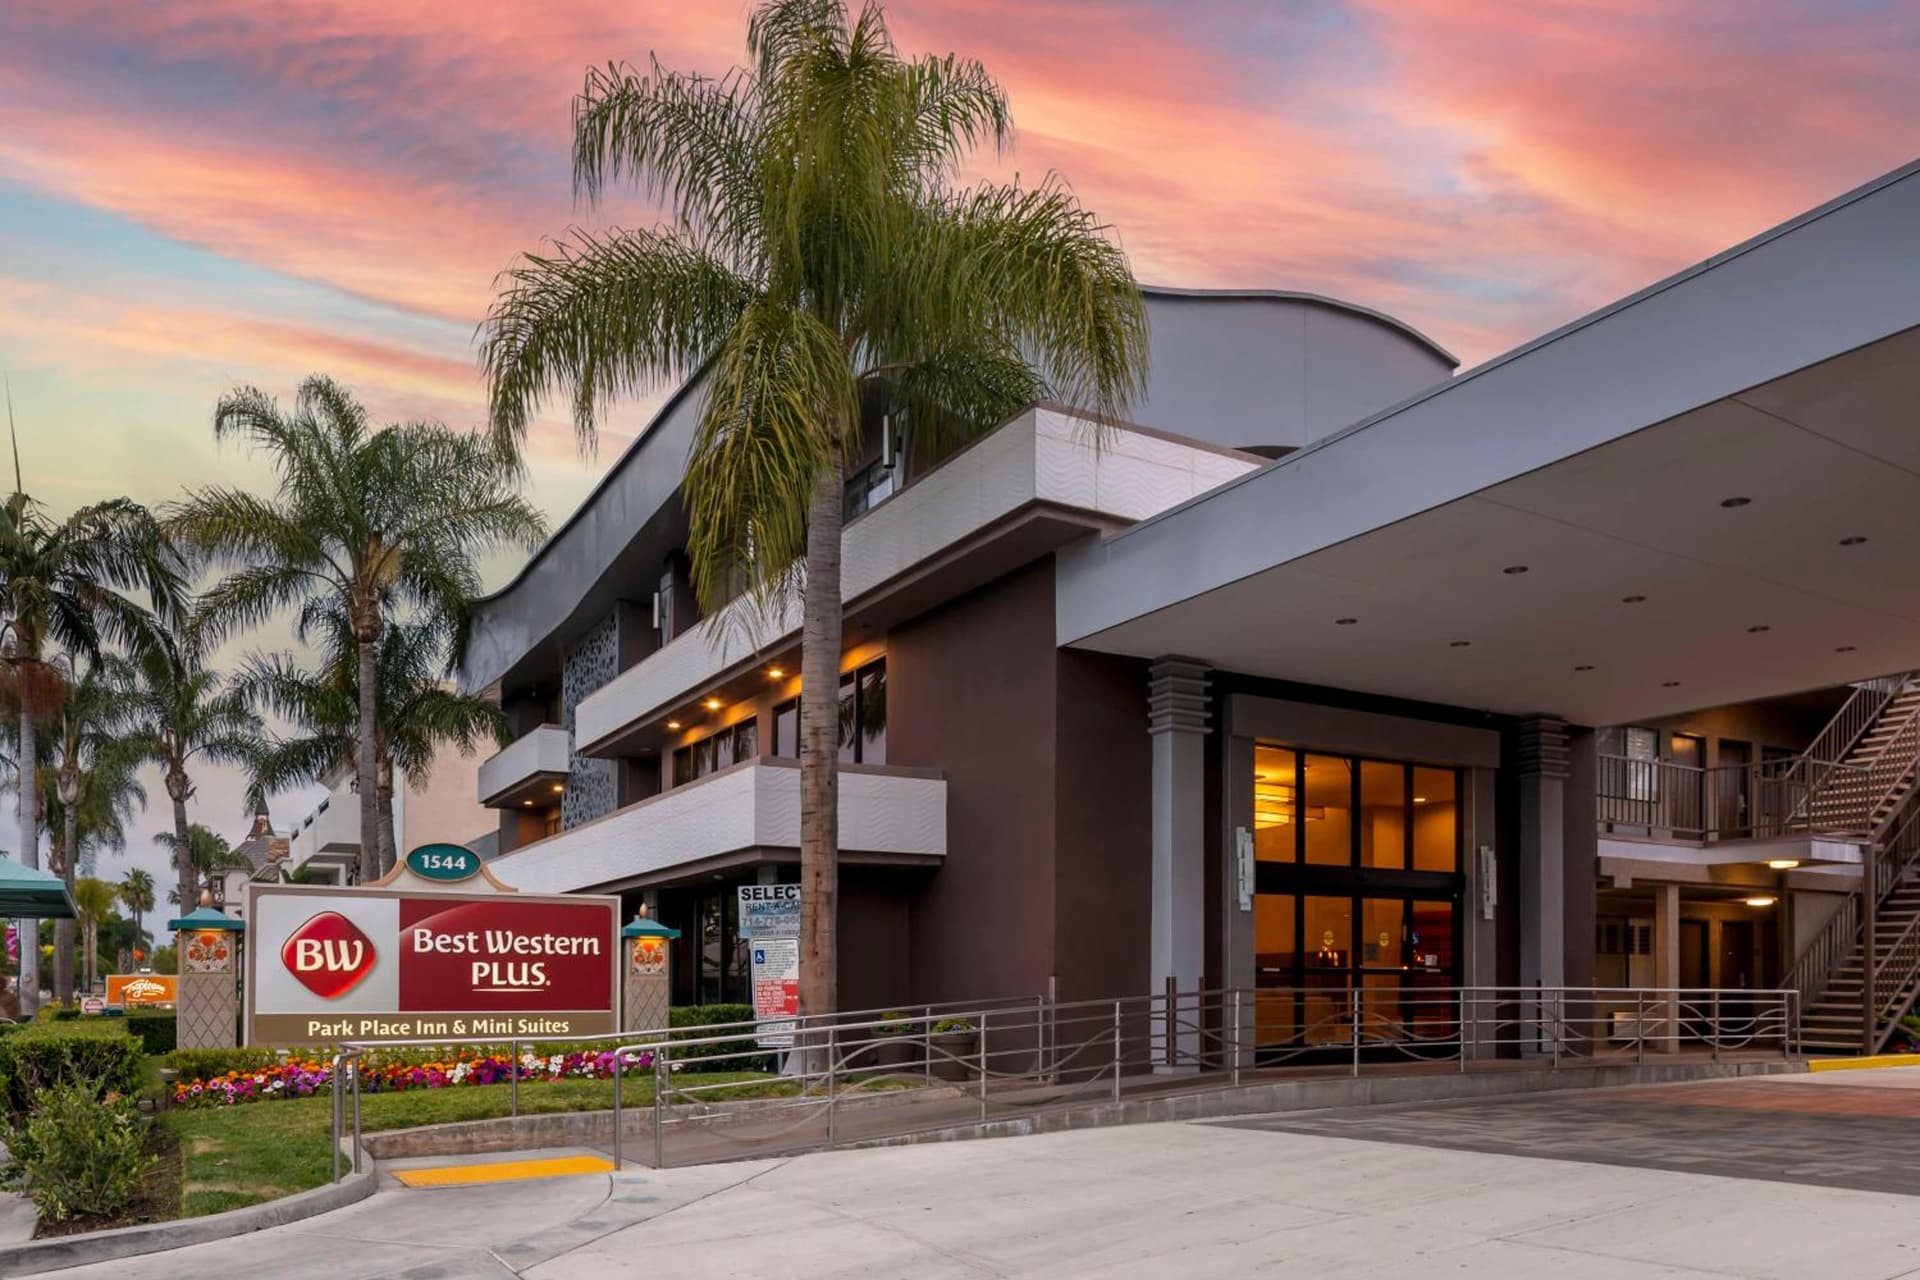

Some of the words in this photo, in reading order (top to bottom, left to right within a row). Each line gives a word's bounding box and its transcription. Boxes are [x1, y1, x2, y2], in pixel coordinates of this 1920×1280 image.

[421, 854, 466, 870] 1544
[413, 928, 479, 954] Best
[485, 930, 601, 956] Western
[295, 938, 364, 972] BW
[307, 1019, 354, 1037] Park
[360, 1019, 411, 1036] Place
[416, 1019, 447, 1035] Inn
[453, 1019, 466, 1035] &
[473, 1018, 513, 1035] Mini
[518, 1018, 570, 1034] Suites
